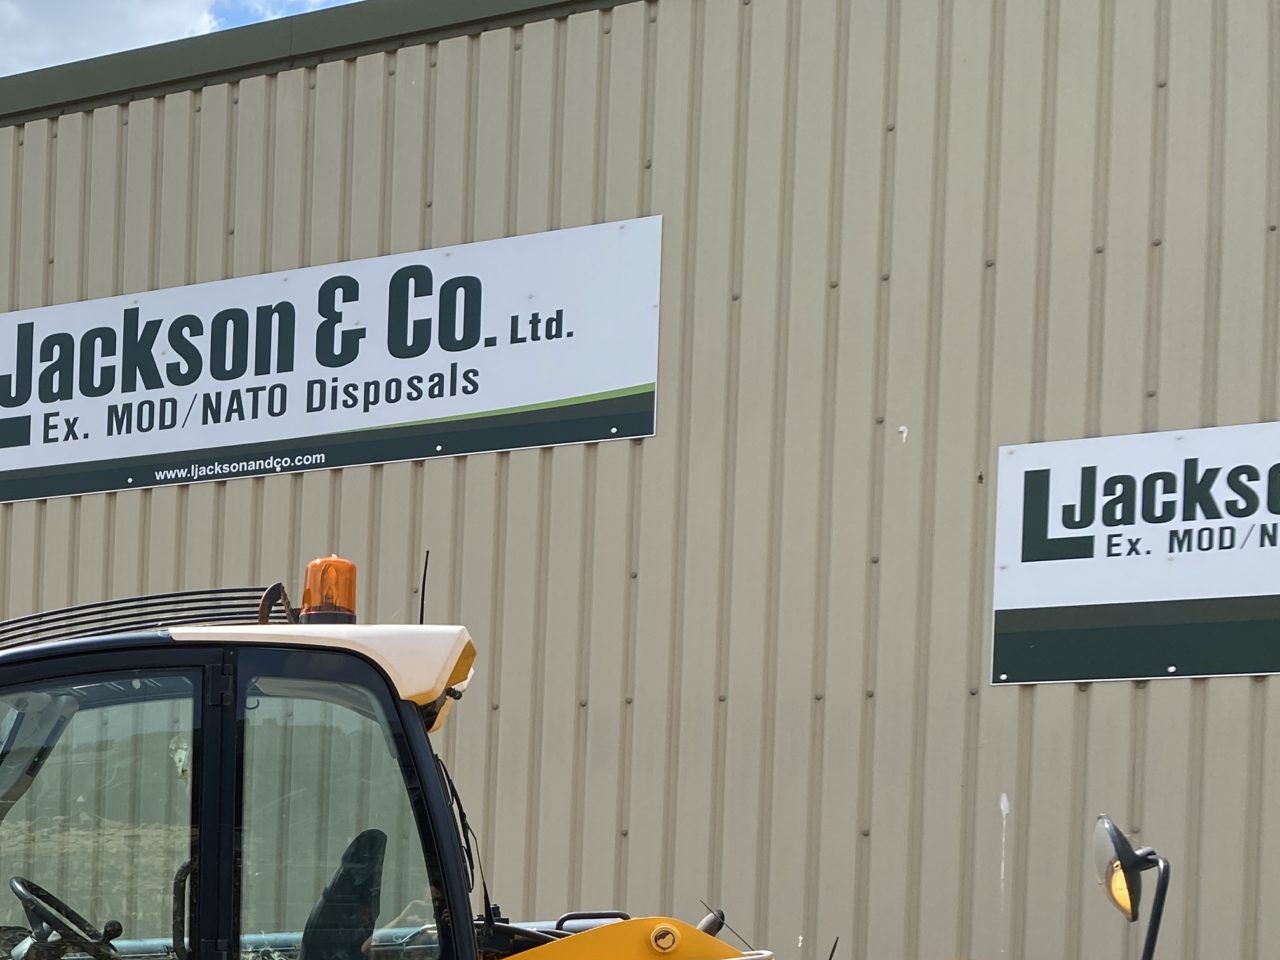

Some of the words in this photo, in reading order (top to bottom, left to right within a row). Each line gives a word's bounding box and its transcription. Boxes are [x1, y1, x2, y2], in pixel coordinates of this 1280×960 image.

[315, 275, 366, 368] &
[387, 264, 497, 359] Co.
[510, 309, 574, 344] Ltd.
[43, 411, 89, 444] Ex.
[107, 383, 287, 437] MOD/NATO
[306, 362, 479, 413] Disposals
[155, 453, 325, 480] www.ljacksonandco.com
[1107, 533, 1151, 558] Ex.
